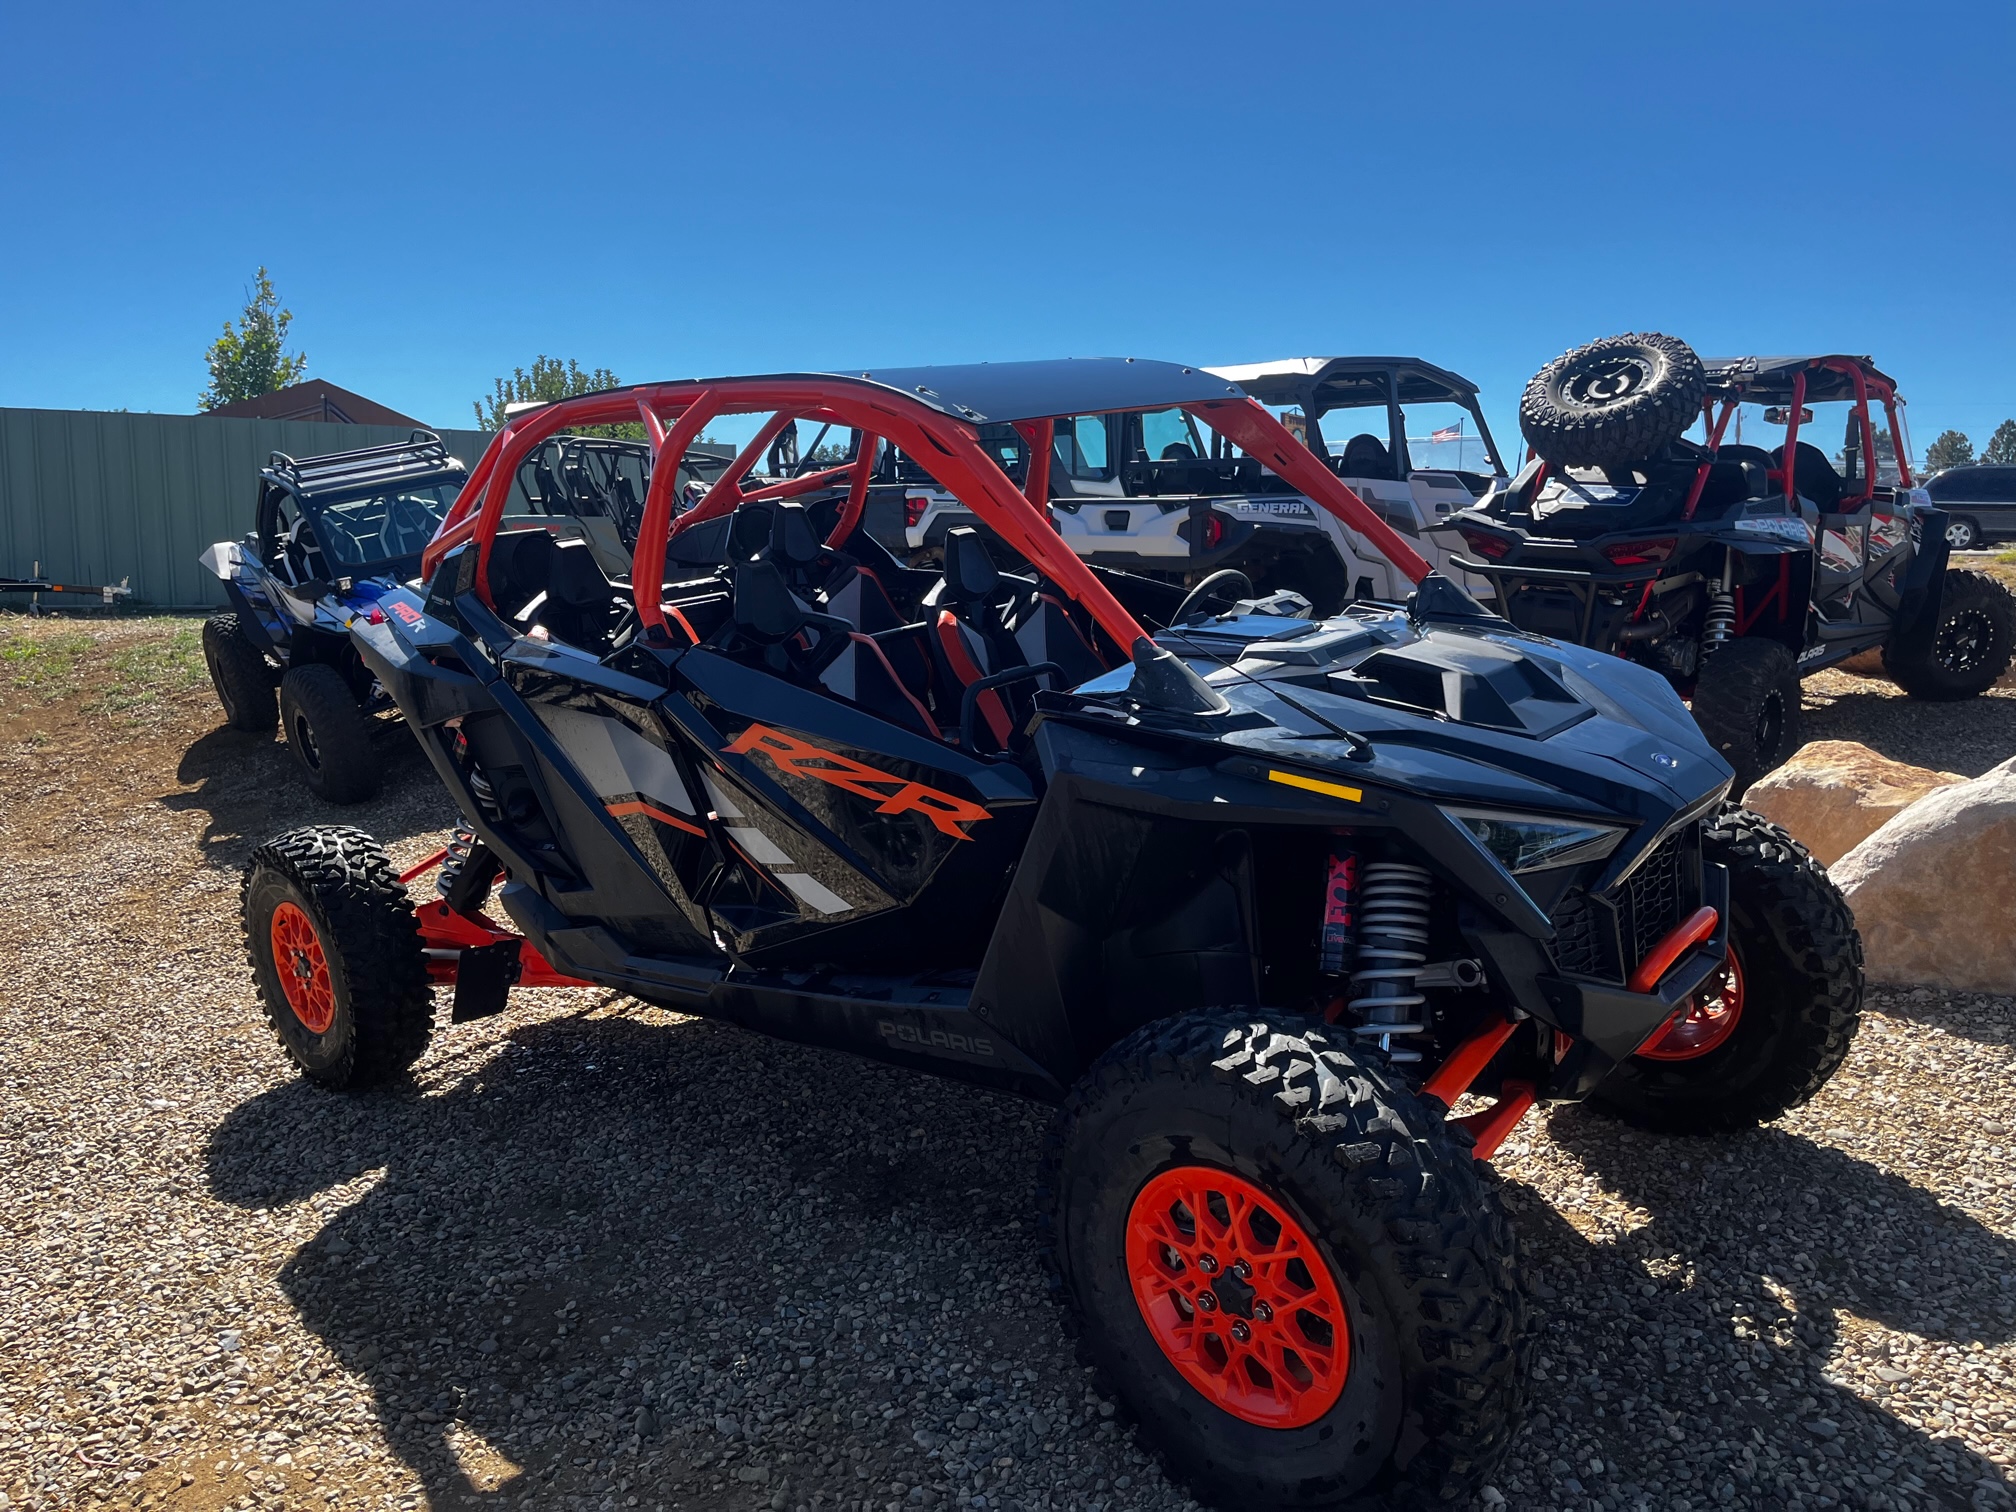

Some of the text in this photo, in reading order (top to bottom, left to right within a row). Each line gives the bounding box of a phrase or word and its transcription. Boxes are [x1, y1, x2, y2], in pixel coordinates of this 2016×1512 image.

[1236, 502, 1308, 514] GENERAL
[1755, 518, 1808, 538] POLARIS
[388, 601, 423, 624] PRO
[1796, 643, 1827, 664] OLARIS
[719, 722, 994, 842] RZR
[1324, 854, 1356, 927] FOX
[878, 1020, 994, 1056] POLARIS
